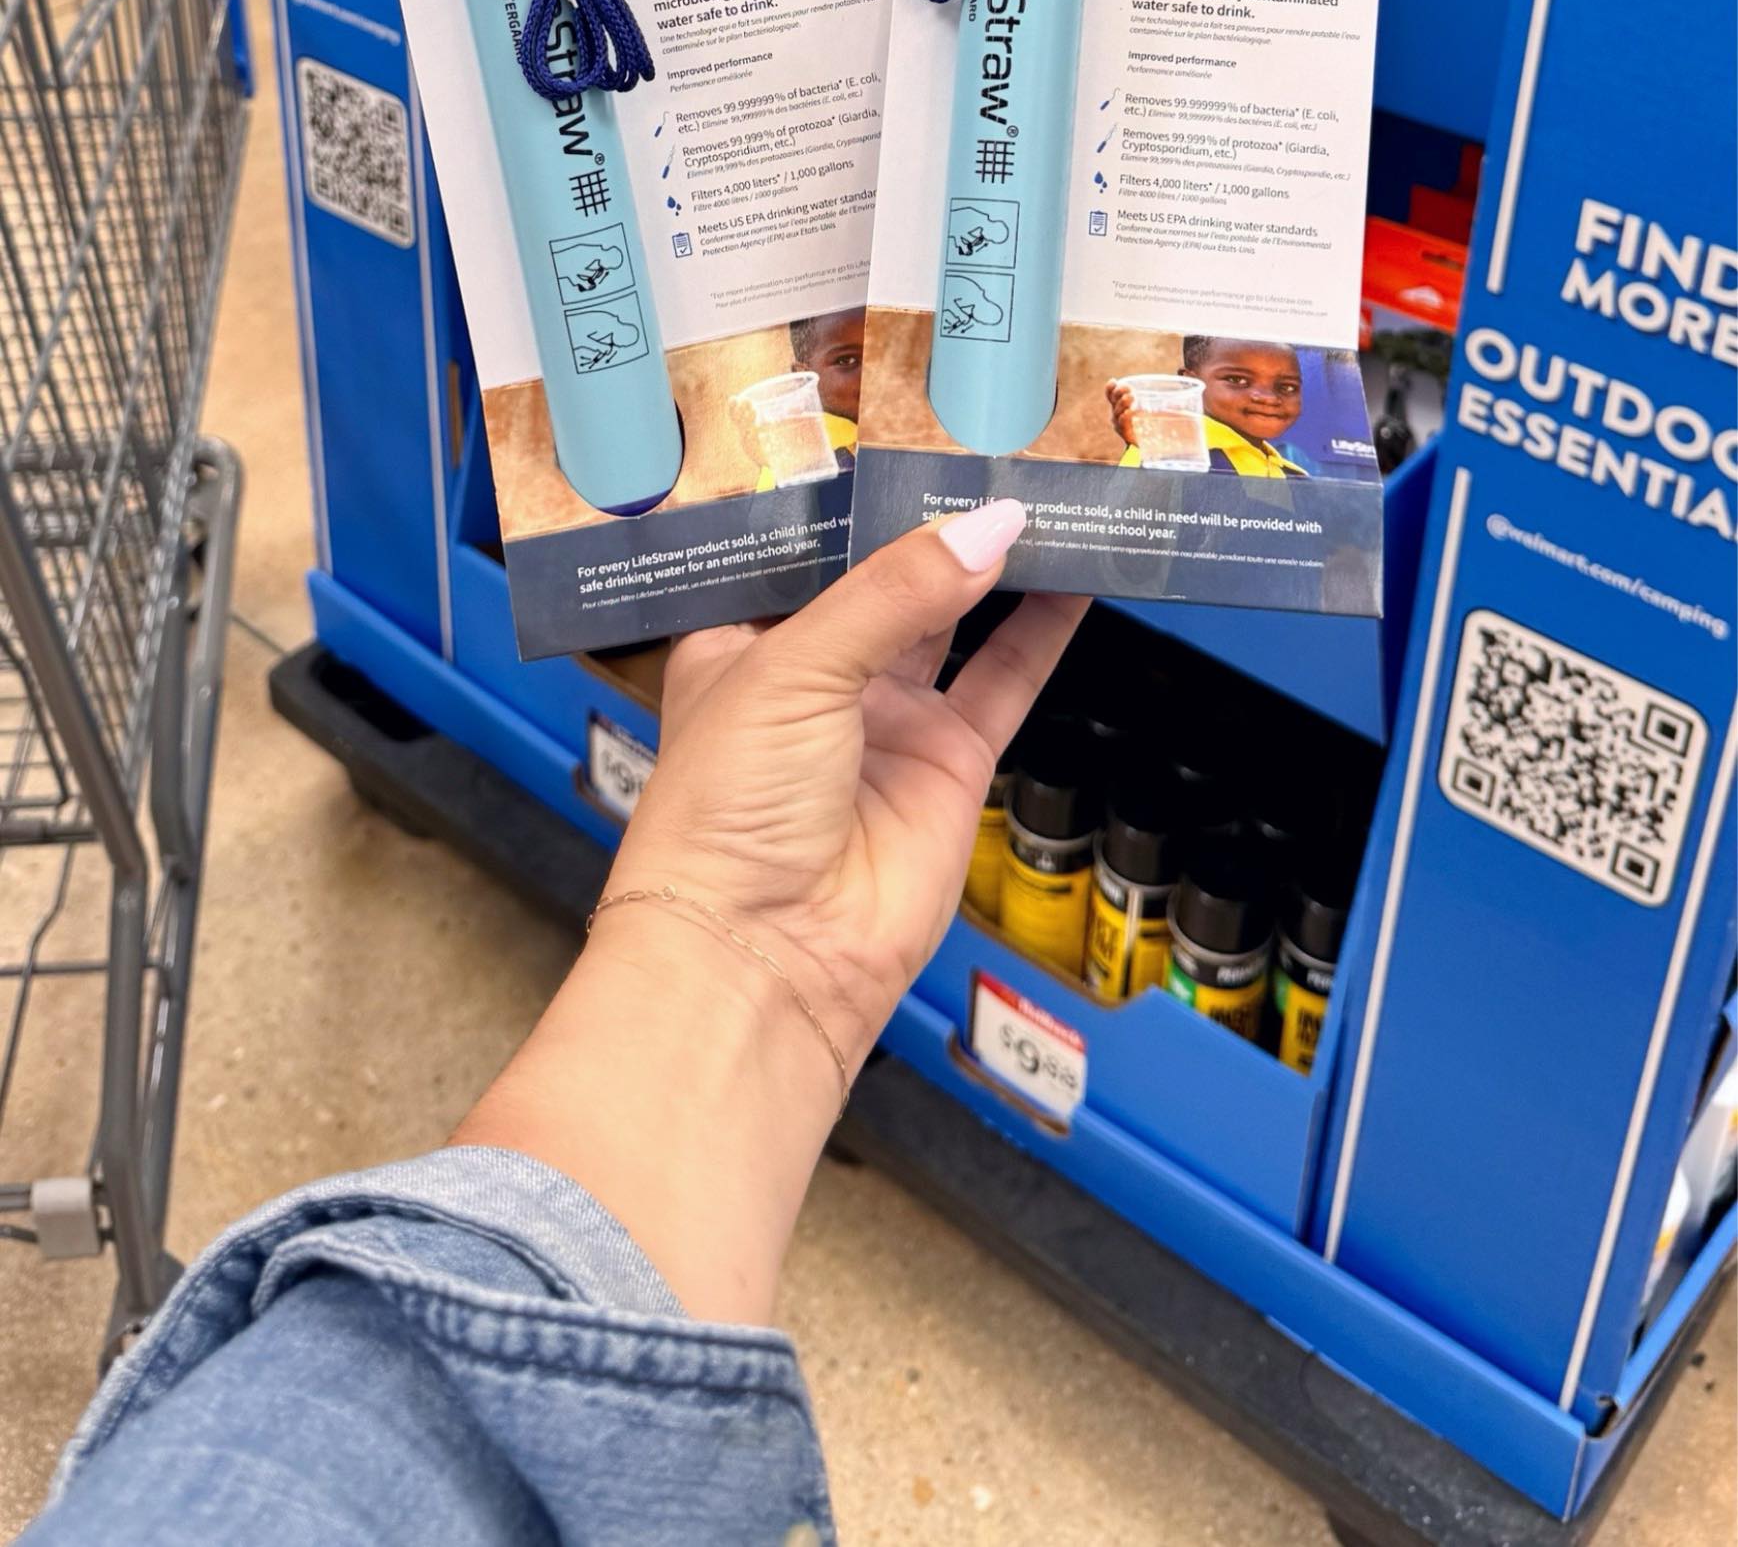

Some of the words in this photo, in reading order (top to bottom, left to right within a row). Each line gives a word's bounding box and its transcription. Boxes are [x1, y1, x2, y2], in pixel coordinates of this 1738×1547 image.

[656, 14, 693, 30] water
[695, 6, 722, 23] safe
[723, 5, 738, 17] to
[1131, 0, 1170, 11] water
[1170, 0, 1198, 14] safe
[1200, 3, 1215, 15] to
[1215, 3, 1255, 19] drink.
[666, 62, 713, 80] Improved
[712, 51, 773, 73] performance
[1127, 49, 1174, 63] Improved
[1174, 54, 1237, 68] performance
[690, 187, 723, 201] Filters
[723, 179, 751, 194] 4,000
[782, 170, 788, 184] /
[789, 165, 817, 181] 1,000
[817, 159, 854, 177] gallons
[1119, 173, 1152, 187] Filters
[1151, 176, 1182, 189] 4,000
[1213, 181, 1221, 195] /
[1221, 182, 1250, 196] 1,000
[1250, 186, 1290, 199] gallons
[696, 221, 729, 235] Meets
[728, 215, 745, 228] US
[744, 211, 766, 225] EPA
[765, 203, 810, 220] drinking
[808, 197, 838, 211] water
[838, 187, 877, 205] standar
[1116, 208, 1148, 222] Meets
[1149, 211, 1165, 223] US
[1166, 212, 1187, 225] EPA
[1187, 214, 1233, 232] drinking
[1233, 221, 1264, 232] water
[1264, 223, 1318, 237] standards
[1574, 197, 1738, 309] FIND
[1560, 257, 1738, 367] MORE
[1456, 382, 1738, 543] ESSENTIA
[921, 510, 945, 521] saf
[1034, 512, 1052, 530] for
[1053, 520, 1069, 531] an
[1070, 520, 1105, 534] entire
[1106, 521, 1146, 537] school
[1147, 527, 1176, 540] year.
[922, 492, 943, 506] For
[943, 495, 978, 513] every
[1034, 501, 1082, 516] product
[1083, 503, 1113, 520] sold,
[1113, 508, 1122, 519] a
[1122, 506, 1153, 521] child
[1153, 508, 1166, 522] in
[1167, 511, 1198, 524] need
[1198, 512, 1221, 526] will
[1222, 513, 1239, 528] be
[1239, 517, 1292, 532] provided
[1294, 519, 1322, 533] with
[576, 565, 596, 578] For
[597, 559, 630, 575] every
[630, 548, 684, 568] LifeStraw
[685, 538, 730, 560] product
[730, 532, 759, 549] sold,
[759, 532, 767, 543] a
[767, 524, 796, 541] child
[796, 523, 808, 536] in
[809, 515, 837, 532] need
[579, 578, 603, 594] safe
[604, 568, 653, 589] drinking
[652, 564, 686, 579] water
[686, 557, 704, 573] for
[705, 557, 720, 569] an
[721, 550, 755, 566] entire
[754, 540, 793, 559] school
[792, 537, 821, 555] year.
[1486, 512, 1730, 640] @walmart.com/camping
